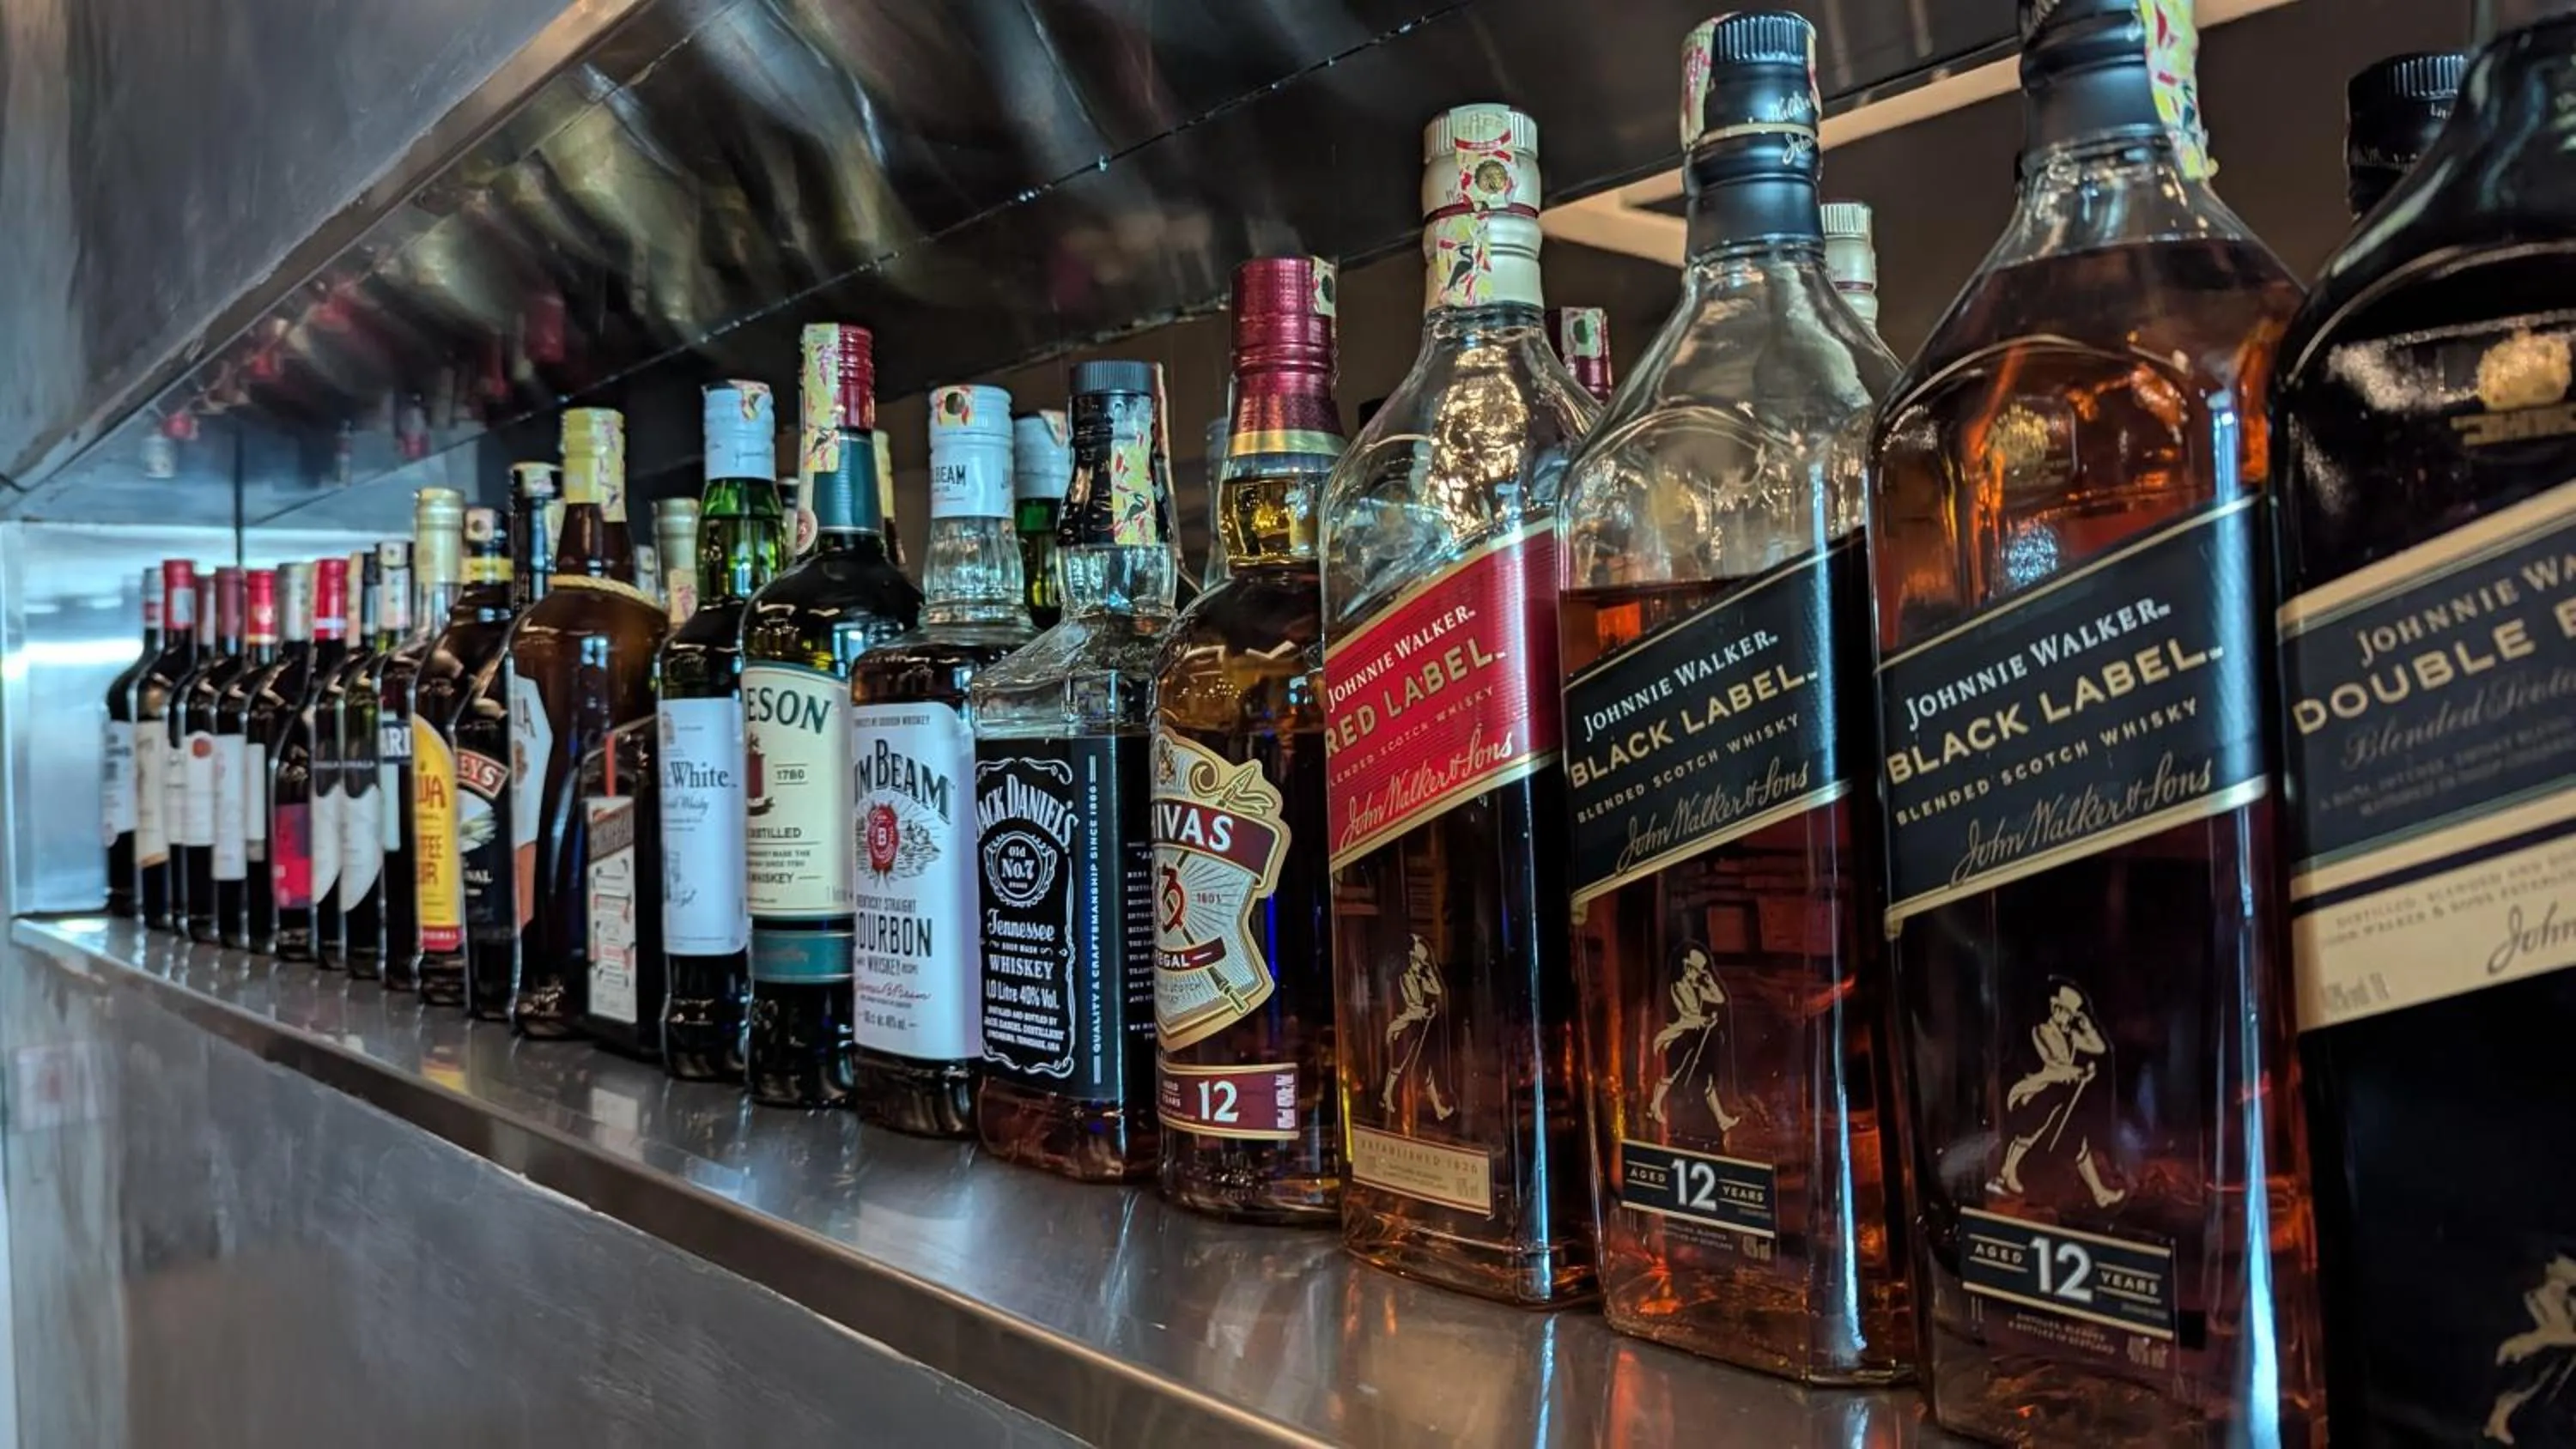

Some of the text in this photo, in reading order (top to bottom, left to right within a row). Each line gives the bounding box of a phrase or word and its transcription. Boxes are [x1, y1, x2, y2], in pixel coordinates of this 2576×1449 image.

[1328, 604, 1469, 714] JOHNNIE WALKER
[1905, 597, 2160, 731] JOHNNIE WALKER
[2293, 617, 2536, 735] DOUBLE
[2357, 578, 2520, 668] JOHNNIE
[1325, 636, 1493, 759] RED LABEL
[1380, 722, 1429, 756] SCOTCH
[1436, 685, 1495, 723] WHISKY
[1570, 664, 1805, 789] BLACK LABEL
[1584, 629, 1771, 743] JOHNNIE WALKER
[1887, 635, 2208, 785] BLACK LABEL
[874, 738, 950, 821] BEAM
[1340, 791, 1387, 851] John
[1386, 758, 1453, 817] Walker
[1461, 728, 1514, 779] Sons
[1577, 713, 1801, 826] BLENDED SCOTCH WHISKY
[1616, 811, 1673, 876] John
[1672, 784, 1745, 843] Walker
[1757, 756, 1809, 806] Sons
[1896, 697, 2198, 828] BLENDED SCOTCH WHISKY
[1008, 846, 1027, 858] Old
[1089, 819, 1099, 859] SINCE
[1948, 816, 2025, 888] John
[2023, 784, 2127, 846] Walker
[2143, 751, 2213, 811] Sons
[987, 907, 1056, 943] Tennessee
[988, 954, 1055, 981] WHISKEY
[1090, 863, 1101, 978] CRAFTSMANSHIP
[1091, 993, 1102, 1054] QUALITY
[1198, 1080, 1240, 1123] 12
[1631, 1159, 1765, 1212] AGED 12 YEARS
[1974, 1236, 2160, 1304] AGED 12 YEARS
